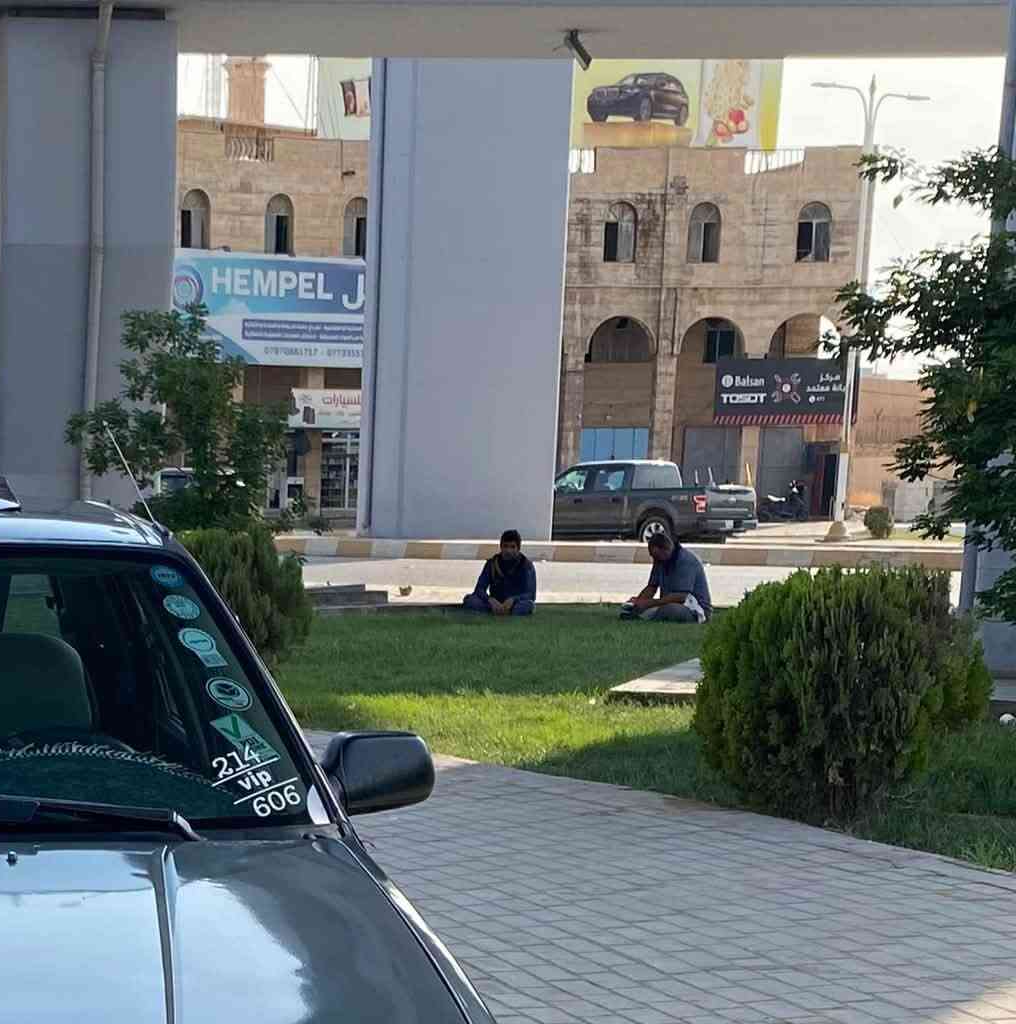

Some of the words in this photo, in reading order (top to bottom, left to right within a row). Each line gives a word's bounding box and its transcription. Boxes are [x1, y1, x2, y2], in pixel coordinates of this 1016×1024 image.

[211, 267, 334, 301] HEMPEL
[735, 375, 765, 387] Balsan
[721, 392, 767, 404] TOSOT
[212, 744, 262, 778] 214
[237, 769, 272, 791] vip
[252, 784, 302, 818] 606
